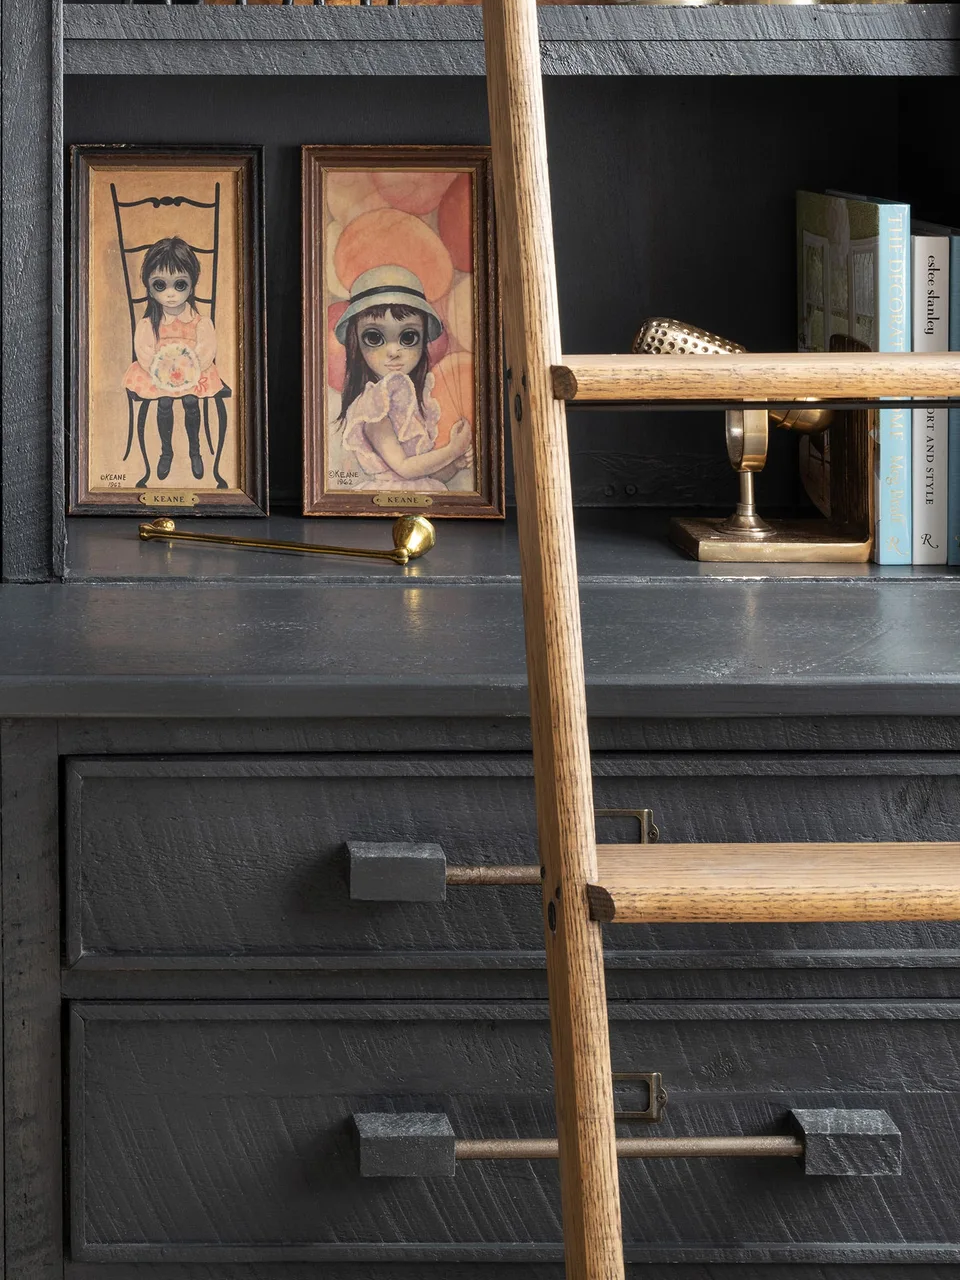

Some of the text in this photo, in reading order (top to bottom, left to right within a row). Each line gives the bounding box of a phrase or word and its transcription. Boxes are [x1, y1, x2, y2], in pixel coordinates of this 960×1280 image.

[887, 213, 903, 252] THE
[887, 260, 904, 352] DECORAT
[923, 255, 940, 335] estee stanley
[925, 435, 934, 463] AND
[925, 467, 934, 505] STYLE
